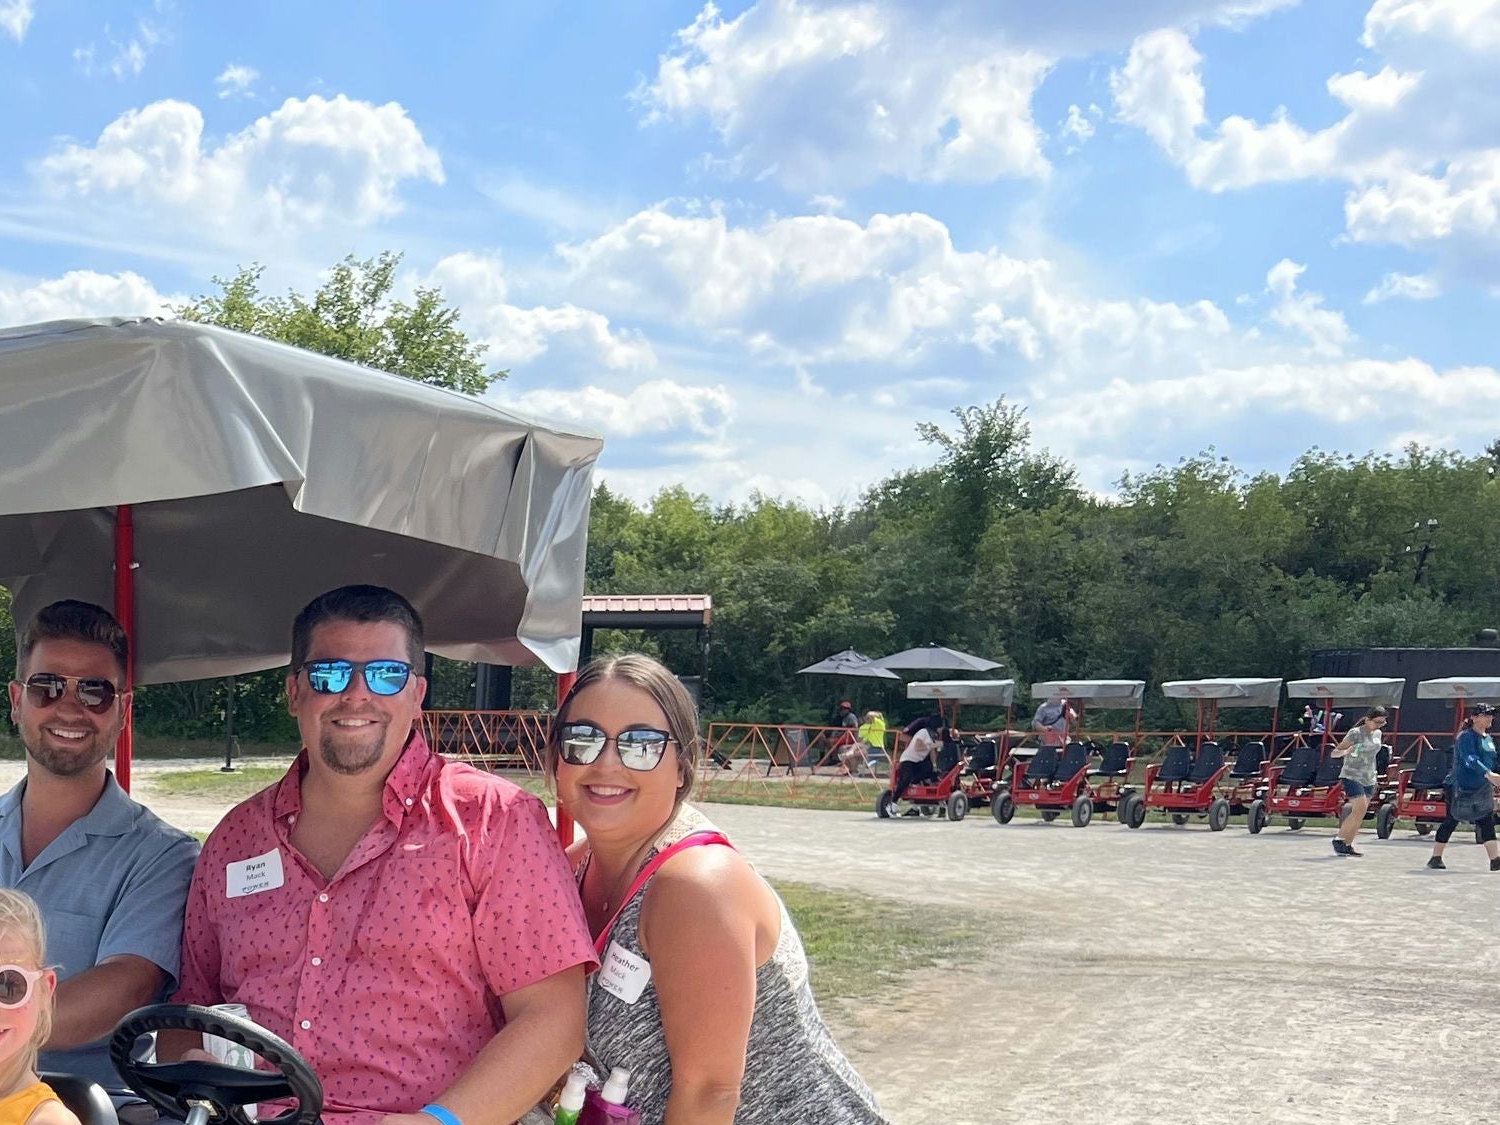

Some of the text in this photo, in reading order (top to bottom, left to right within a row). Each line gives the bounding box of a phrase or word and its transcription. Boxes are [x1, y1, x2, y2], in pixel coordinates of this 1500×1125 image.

[246, 862, 266, 871] Ryan
[246, 871, 266, 880] Mack
[610, 952, 640, 972] Heather
